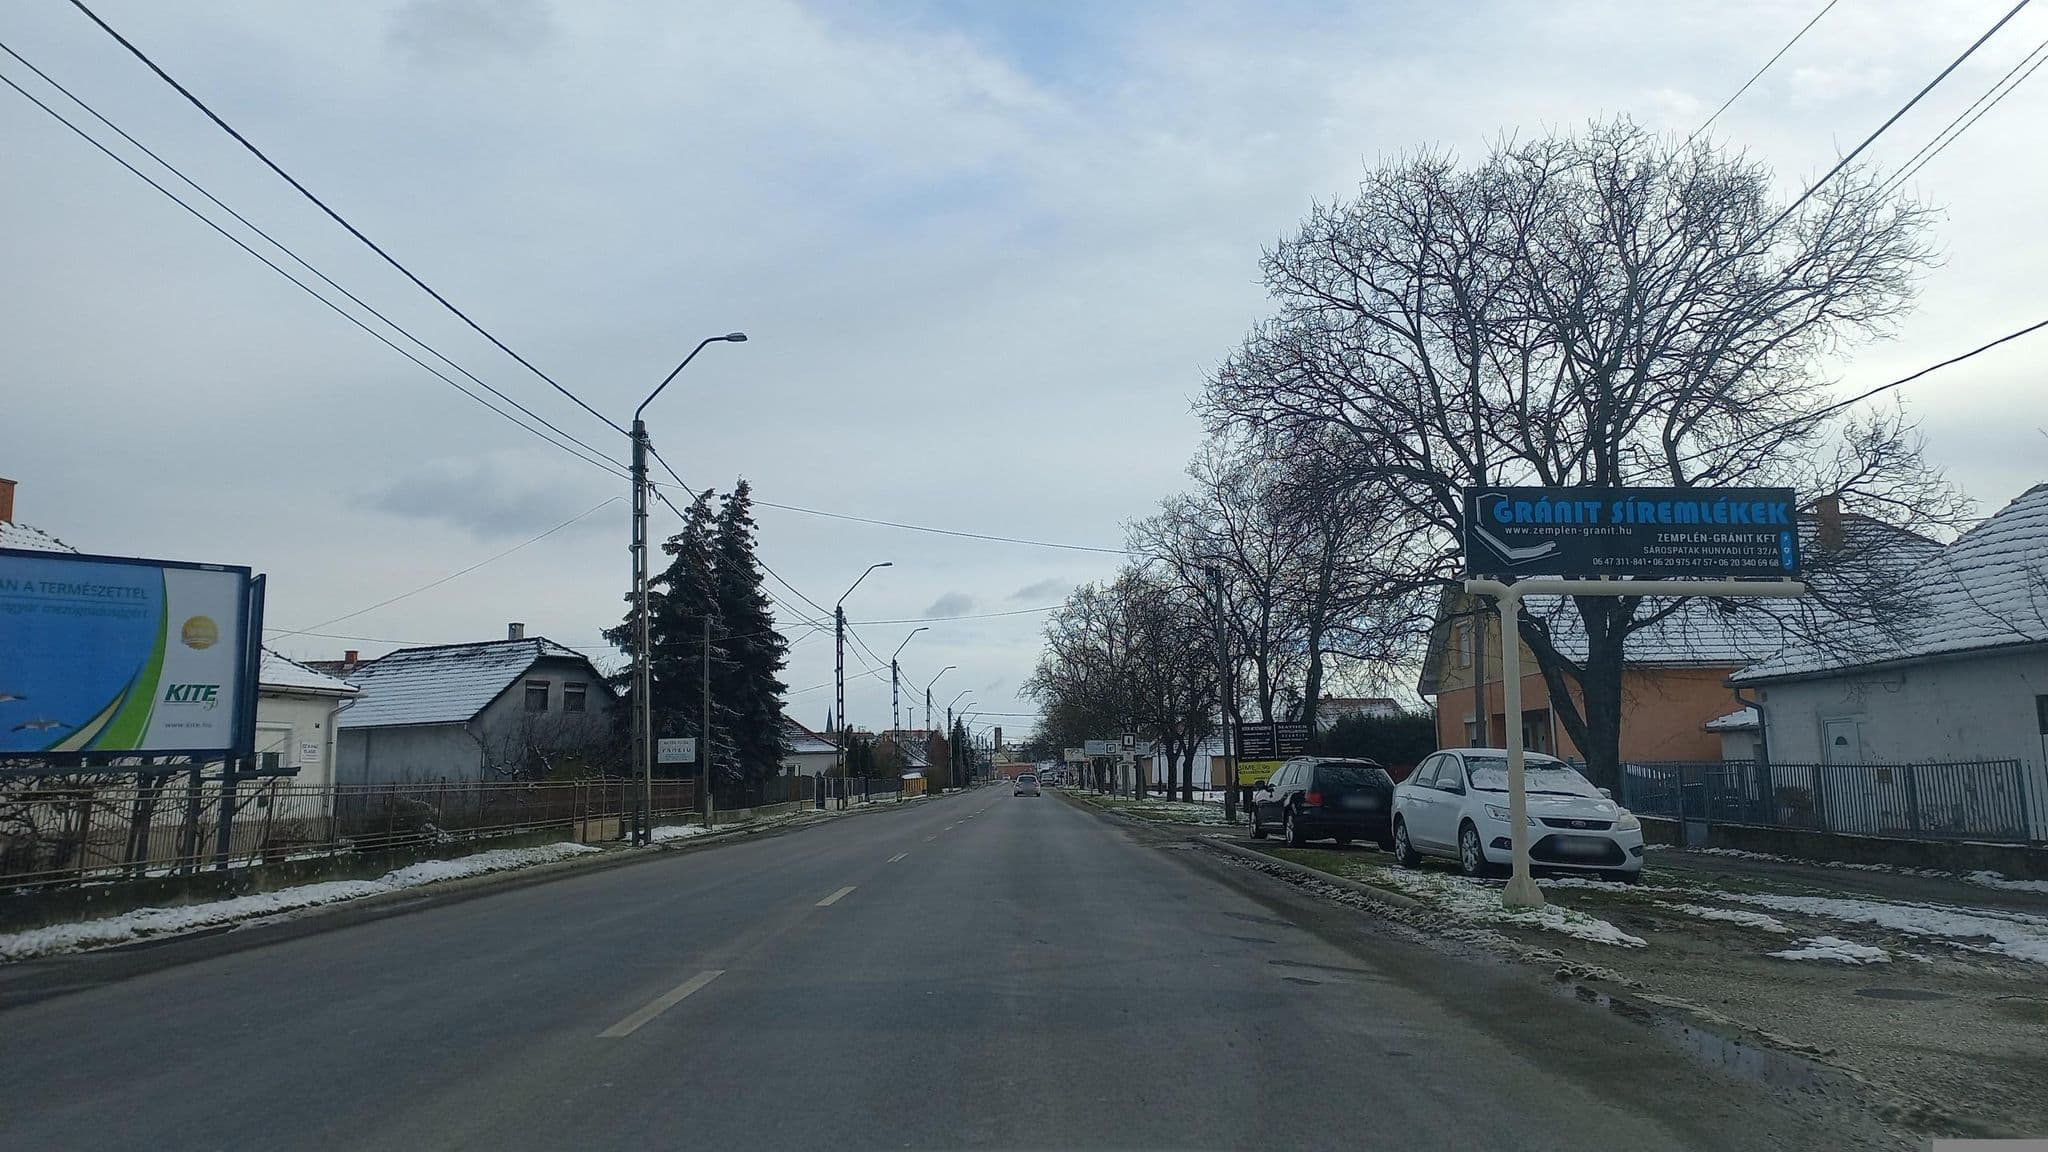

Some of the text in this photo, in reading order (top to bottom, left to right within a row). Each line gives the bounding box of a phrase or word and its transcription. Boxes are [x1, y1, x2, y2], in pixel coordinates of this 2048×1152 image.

[1493, 496, 1789, 525] GRÁNIT SÍREMLÉKEK
[1504, 525, 1633, 537] www.zemplen-granit.hu
[1657, 531, 1777, 544] ZEMPLÉN-GRÁNIT KFT
[1643, 545, 1779, 555] SÁROSPATAK HUNYADI ÚT 32/A
[23, 581, 34, 593] A
[39, 581, 149, 600] TERMÉSZETTEL
[165, 683, 220, 702] KITE
